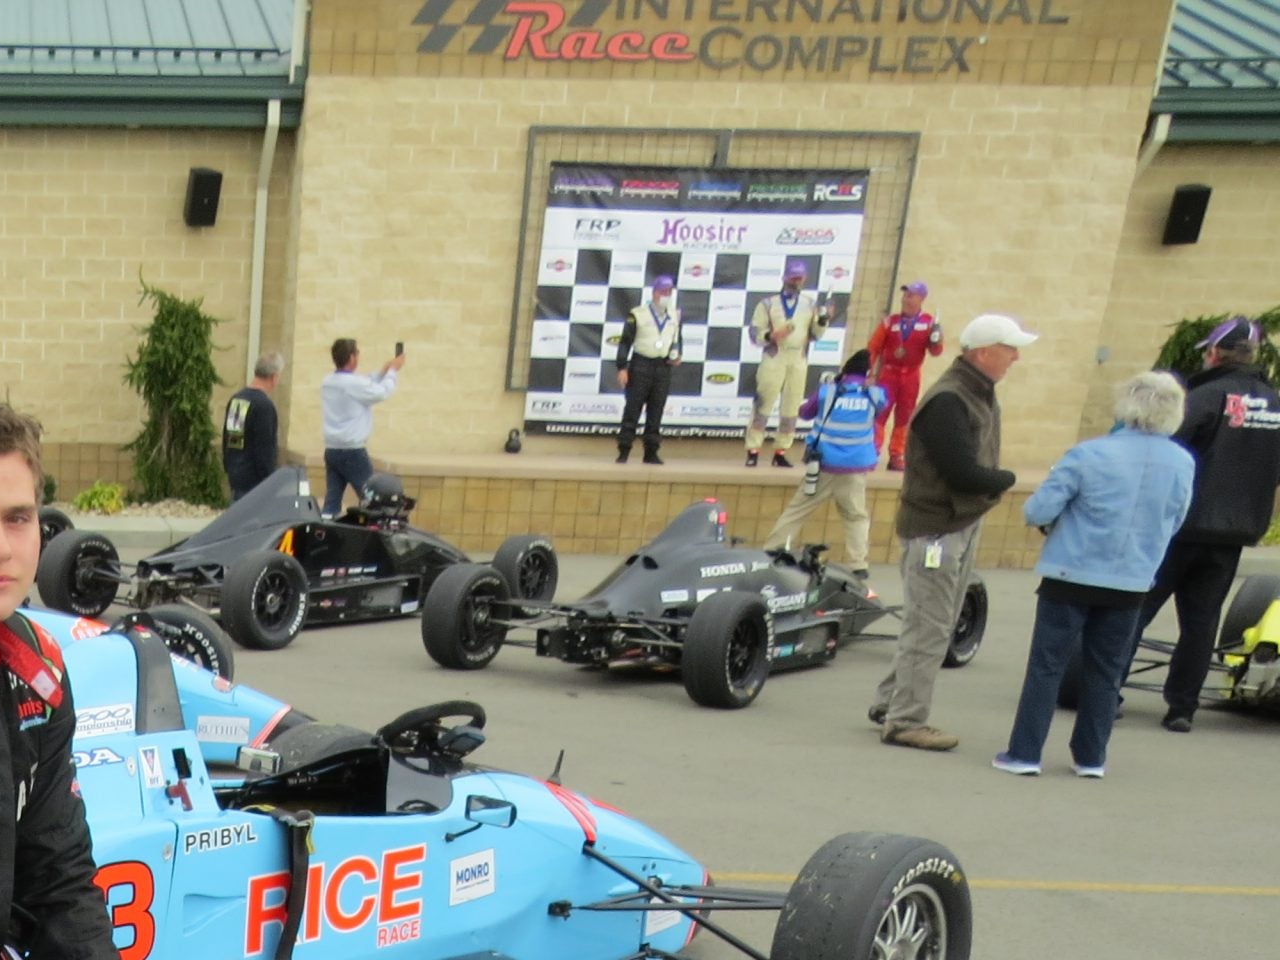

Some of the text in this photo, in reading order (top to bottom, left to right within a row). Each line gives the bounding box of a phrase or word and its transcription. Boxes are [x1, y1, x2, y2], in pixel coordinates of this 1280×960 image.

[503, 1, 974, 73] Race COMPLEX
[575, 218, 621, 232] FRP
[657, 217, 748, 245] Hoosier
[834, 397, 869, 410] PRESS
[701, 562, 746, 578] HONDA
[184, 824, 257, 854] PRIBYL
[455, 861, 490, 886] MONRO
[892, 857, 955, 897] Hoosier
[245, 843, 426, 957] RICE
[377, 920, 420, 948] RACE
